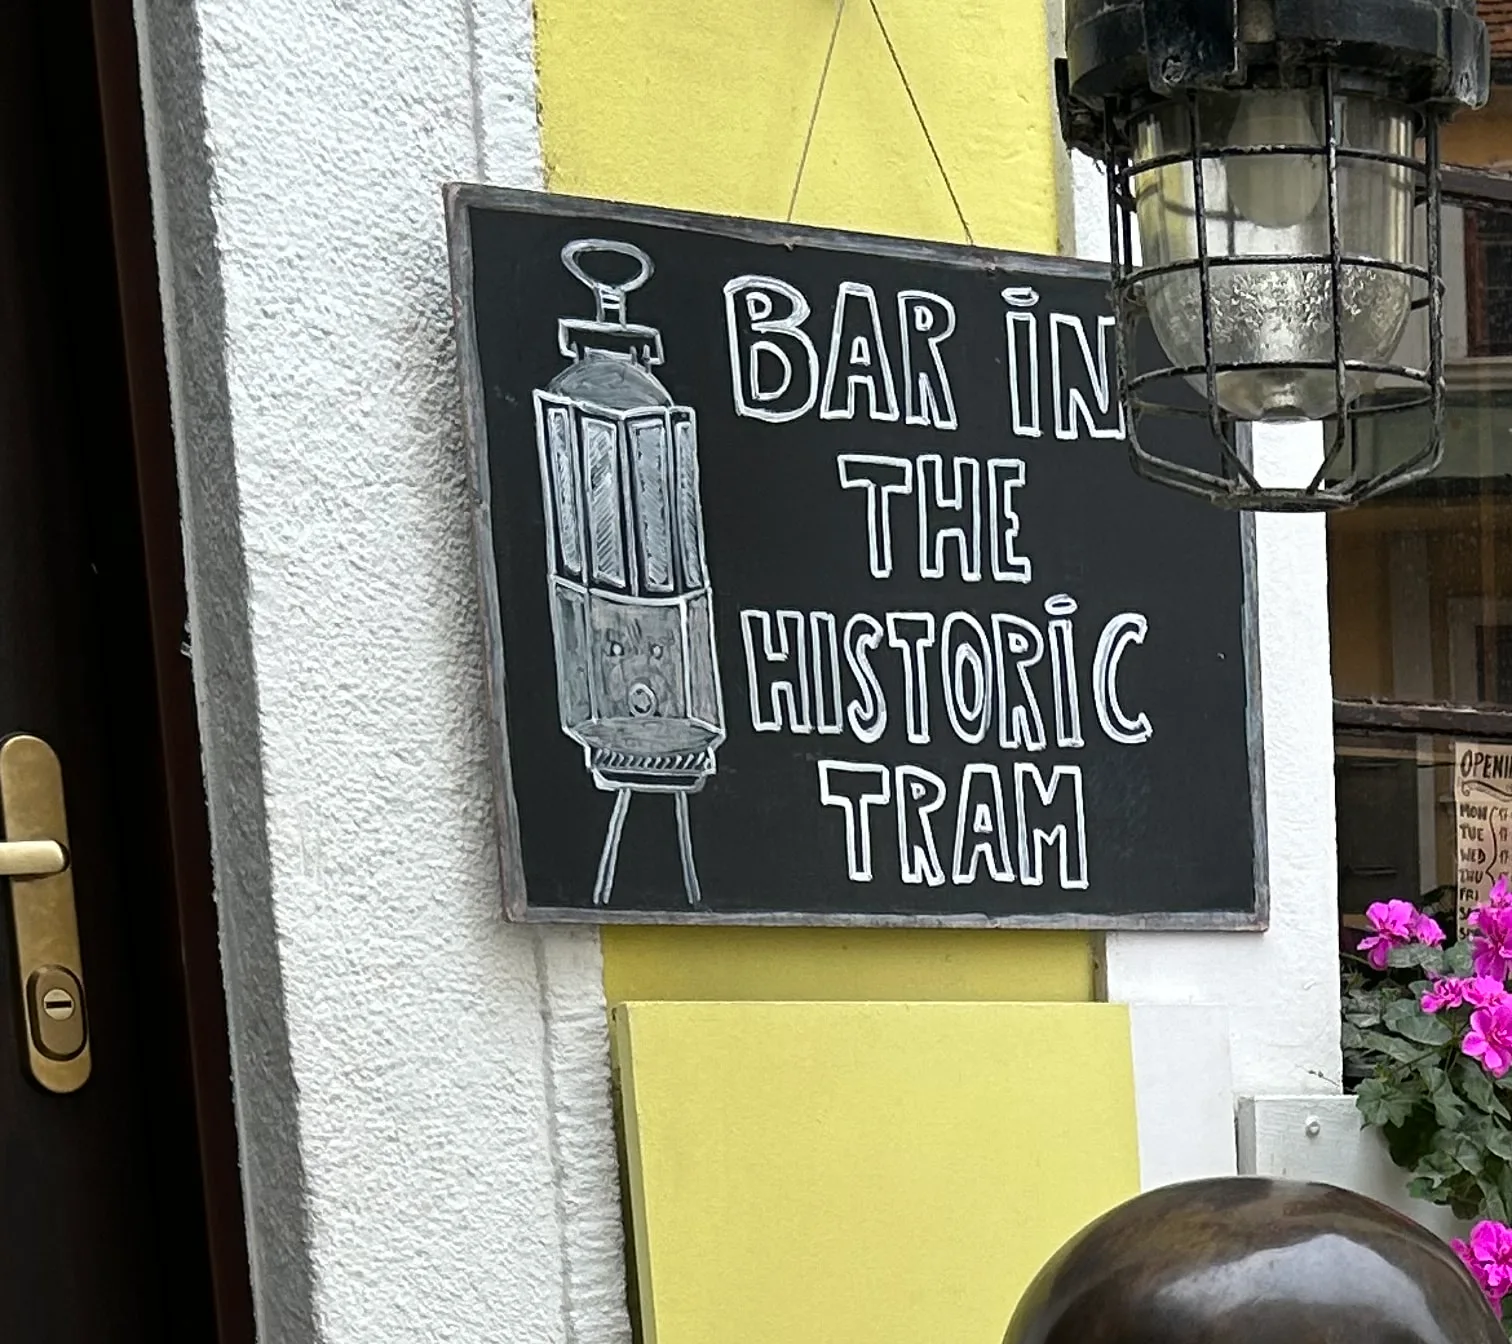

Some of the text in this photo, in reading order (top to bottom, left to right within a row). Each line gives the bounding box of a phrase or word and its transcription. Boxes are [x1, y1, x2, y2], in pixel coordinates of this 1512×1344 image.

[720, 273, 960, 432] BAR
[838, 453, 1034, 583] THE
[1459, 804, 1488, 821] MON
[819, 761, 1091, 891] TRAM
[1460, 825, 1484, 842] TUE
[1460, 848, 1486, 865] WED
[1459, 869, 1484, 884] THU
[1459, 887, 1480, 902] FRI
